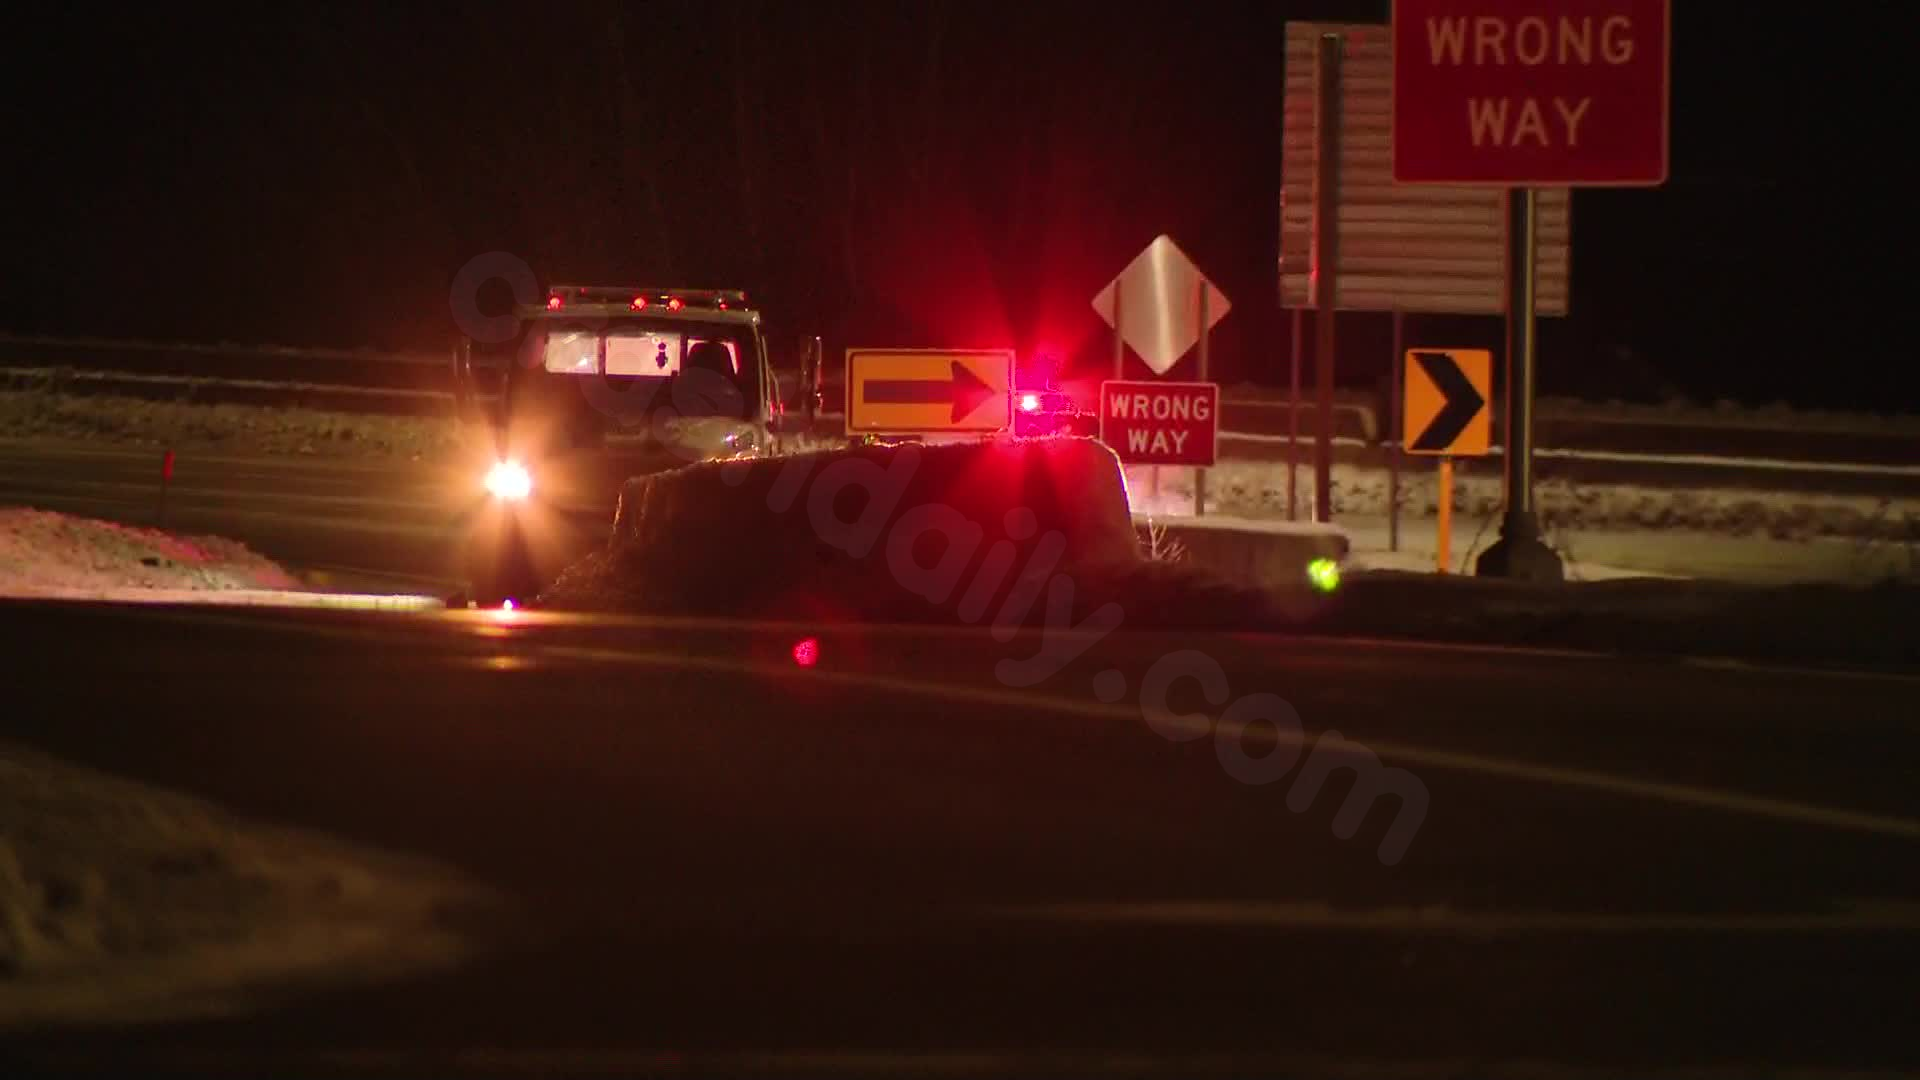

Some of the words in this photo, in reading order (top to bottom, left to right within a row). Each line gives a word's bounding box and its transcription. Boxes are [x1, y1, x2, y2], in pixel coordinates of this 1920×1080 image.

[1425, 15, 1635, 67] WRONG
[1466, 96, 1592, 148] WAY
[1109, 392, 1209, 420] WRONG
[1128, 428, 1189, 455] WAY
